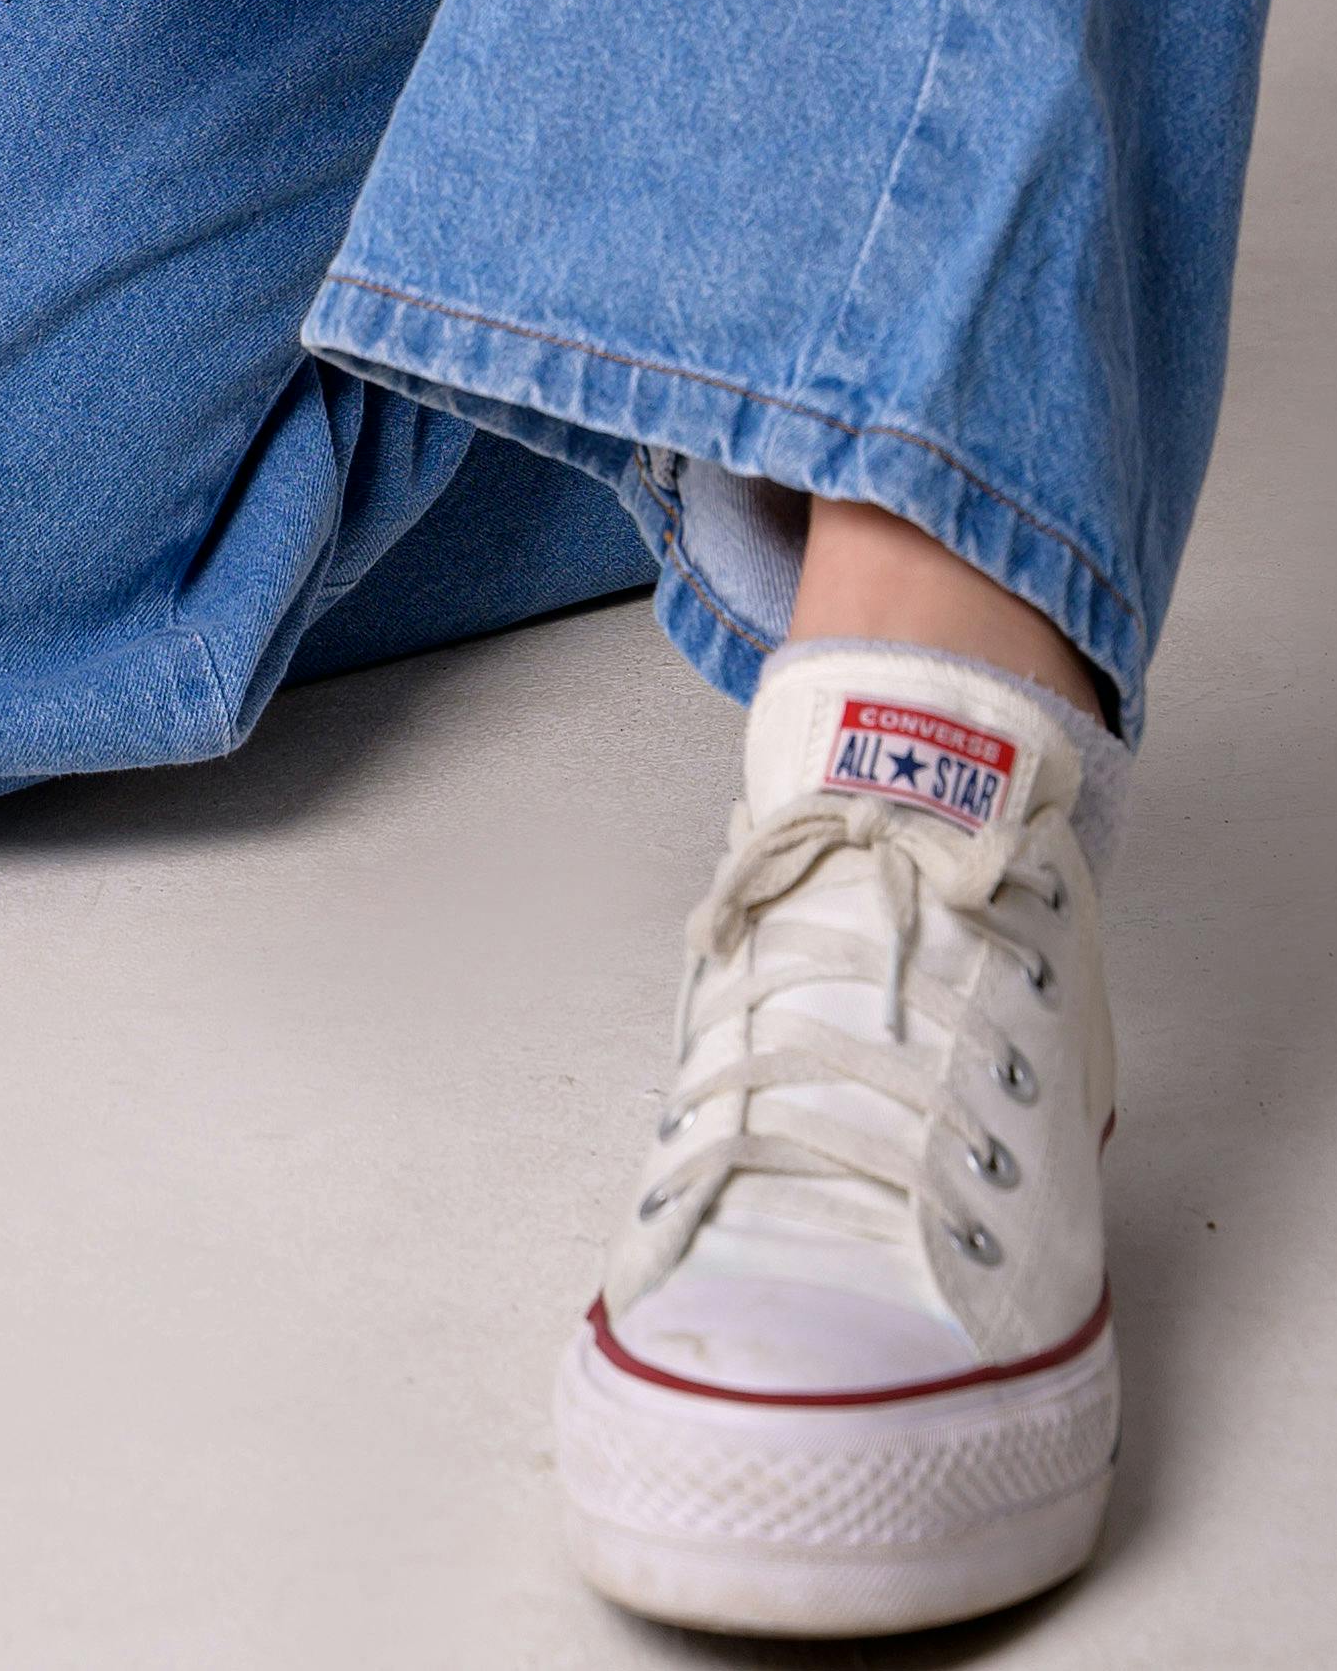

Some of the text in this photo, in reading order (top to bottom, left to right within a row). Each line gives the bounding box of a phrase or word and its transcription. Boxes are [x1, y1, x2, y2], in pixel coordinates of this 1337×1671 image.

[859, 706, 1001, 762] CONVERSE
[836, 734, 999, 821] ALL STAR
